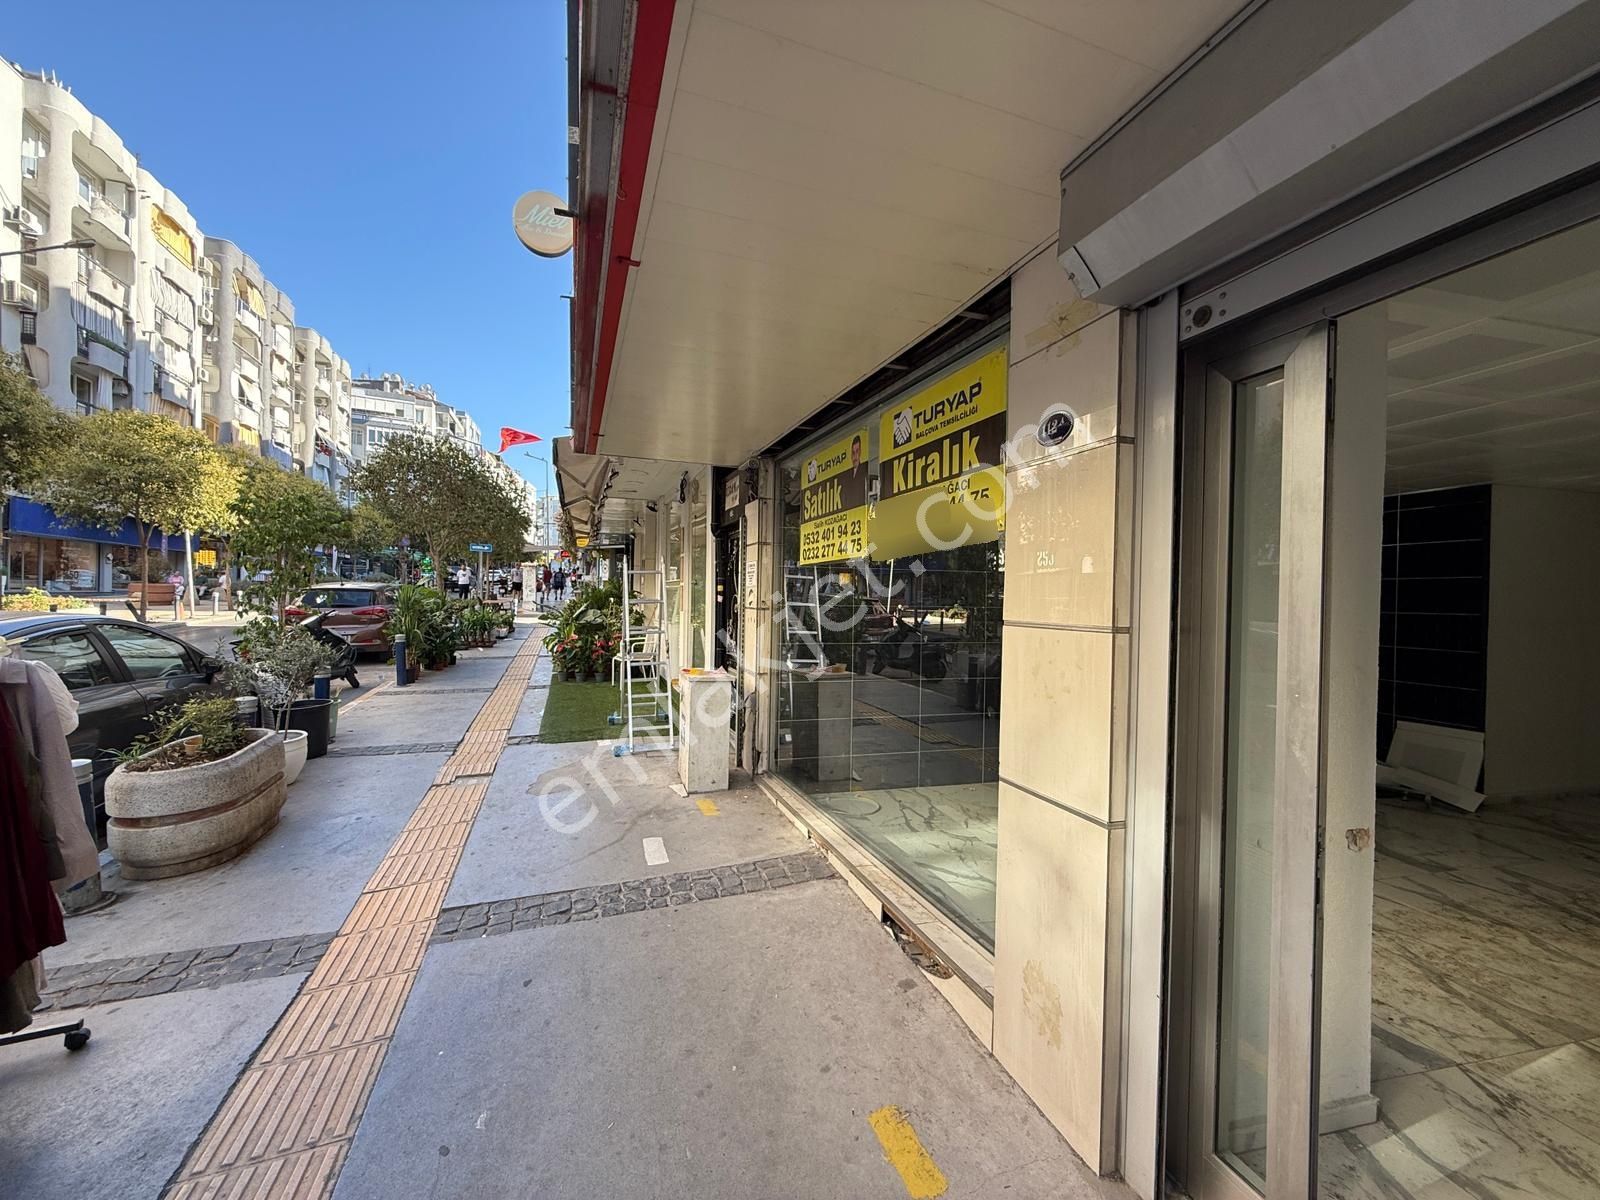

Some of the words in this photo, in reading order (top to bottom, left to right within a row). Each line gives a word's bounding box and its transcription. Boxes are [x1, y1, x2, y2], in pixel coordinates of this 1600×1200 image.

[913, 382, 982, 428] TURYAP
[916, 425, 939, 440] BALÇOVA
[817, 452, 847, 474] TURYAP
[893, 430, 980, 494] Kiralık
[804, 478, 842, 520] Satılık
[821, 527, 835, 542] 401
[838, 523, 848, 538] 94
[850, 520, 861, 536] 23
[803, 546, 820, 561] 0232
[821, 543, 835, 558] 277
[838, 541, 848, 555] 44
[850, 538, 862, 554] 75
